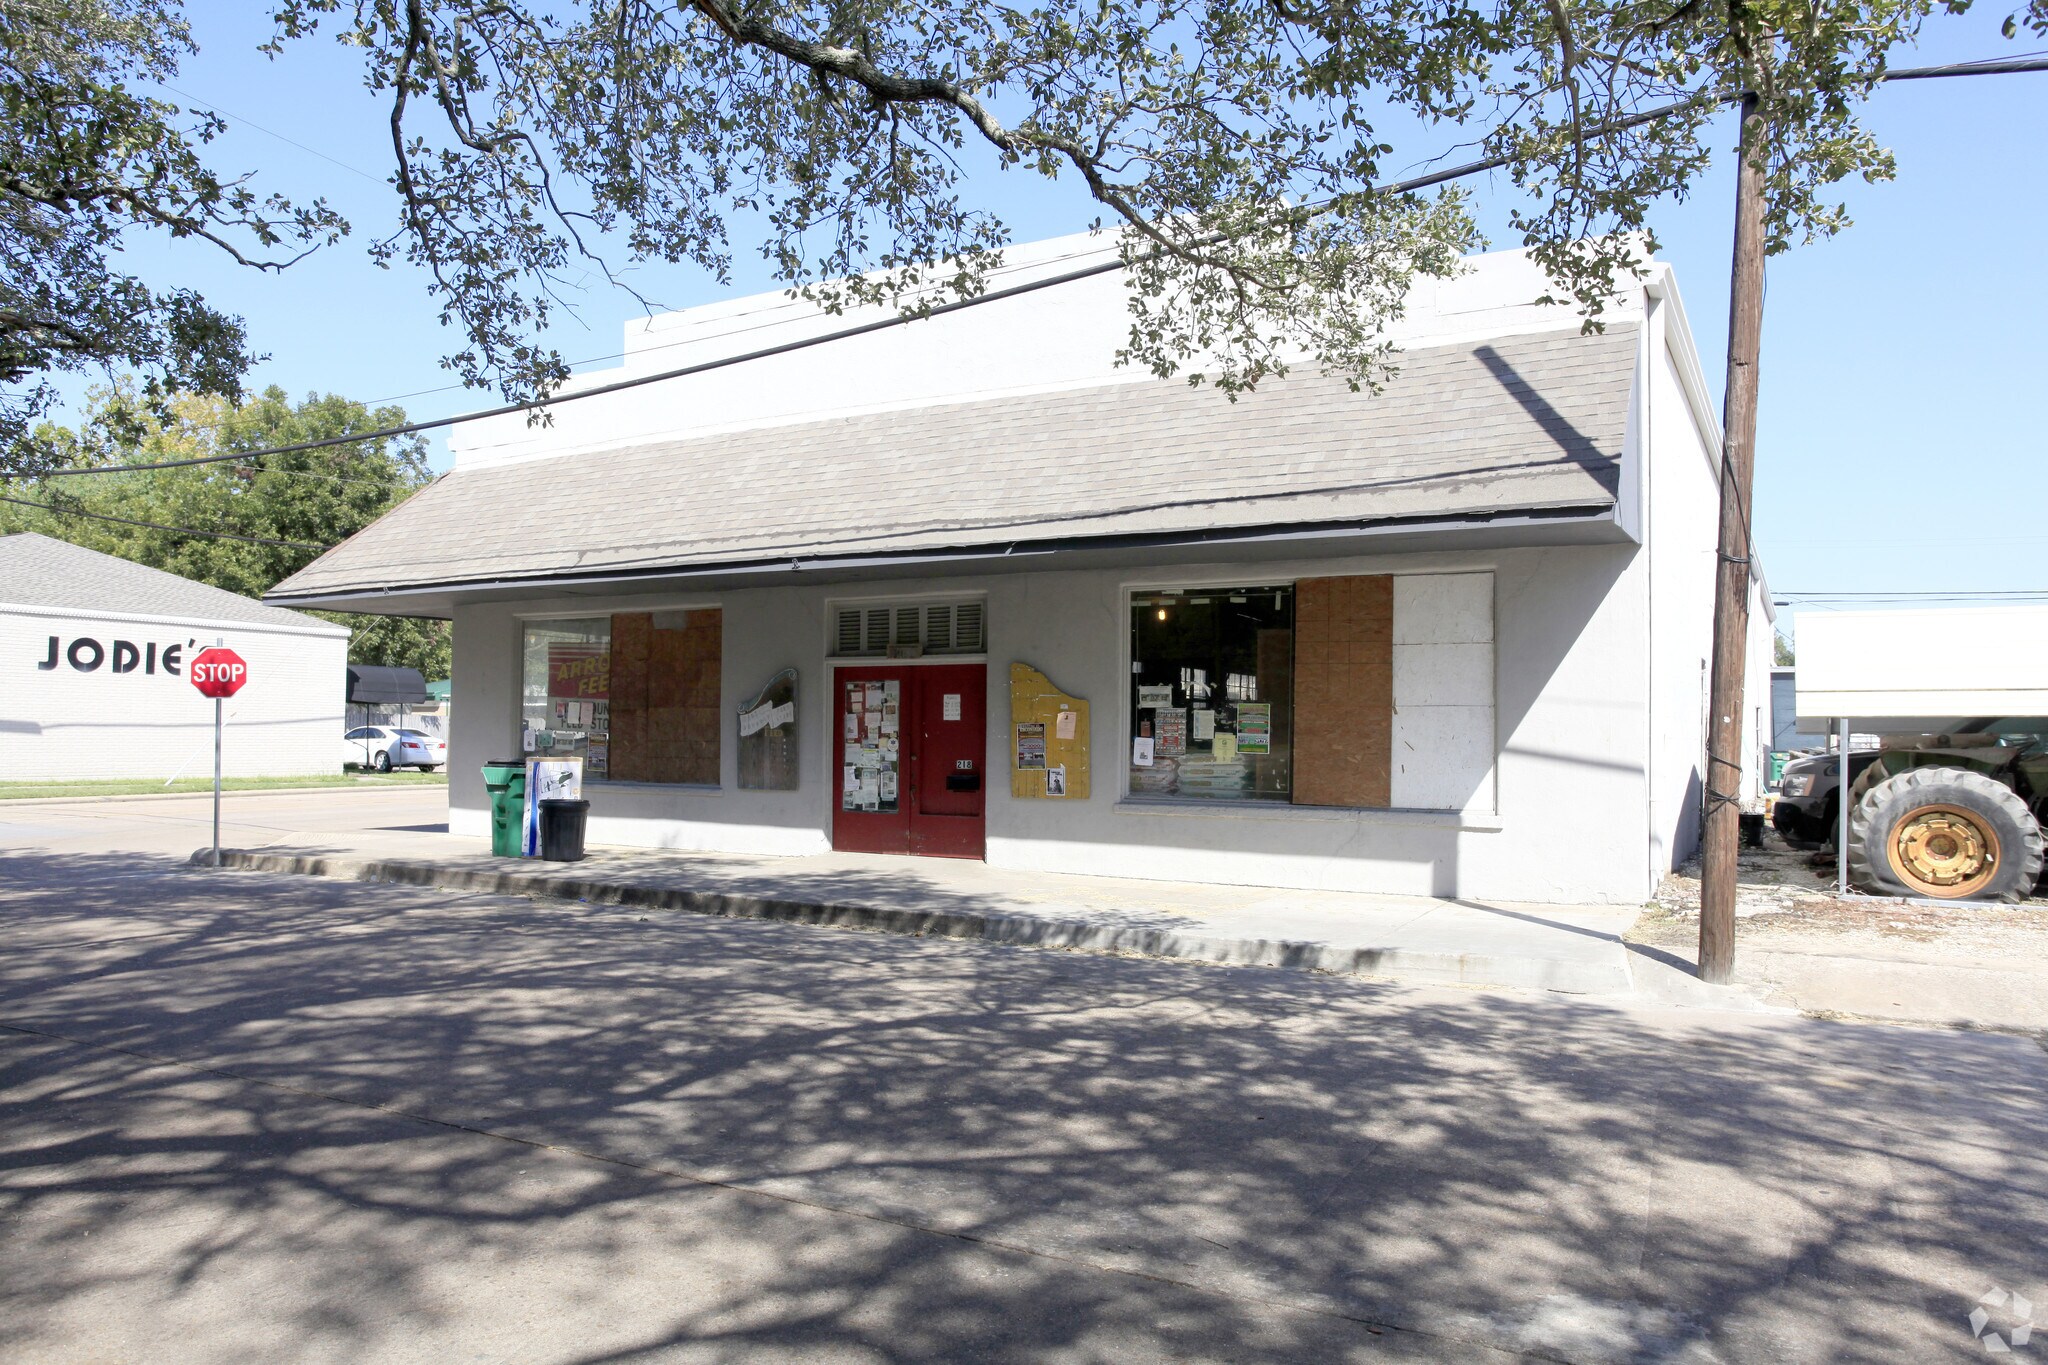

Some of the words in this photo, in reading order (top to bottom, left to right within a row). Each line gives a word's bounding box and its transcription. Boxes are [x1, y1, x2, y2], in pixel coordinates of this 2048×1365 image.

[38, 636, 212, 676] JODIE'
[557, 652, 609, 682] ARRO
[193, 663, 244, 683] STOP
[578, 674, 609, 697] FEE
[957, 760, 972, 769] 218
